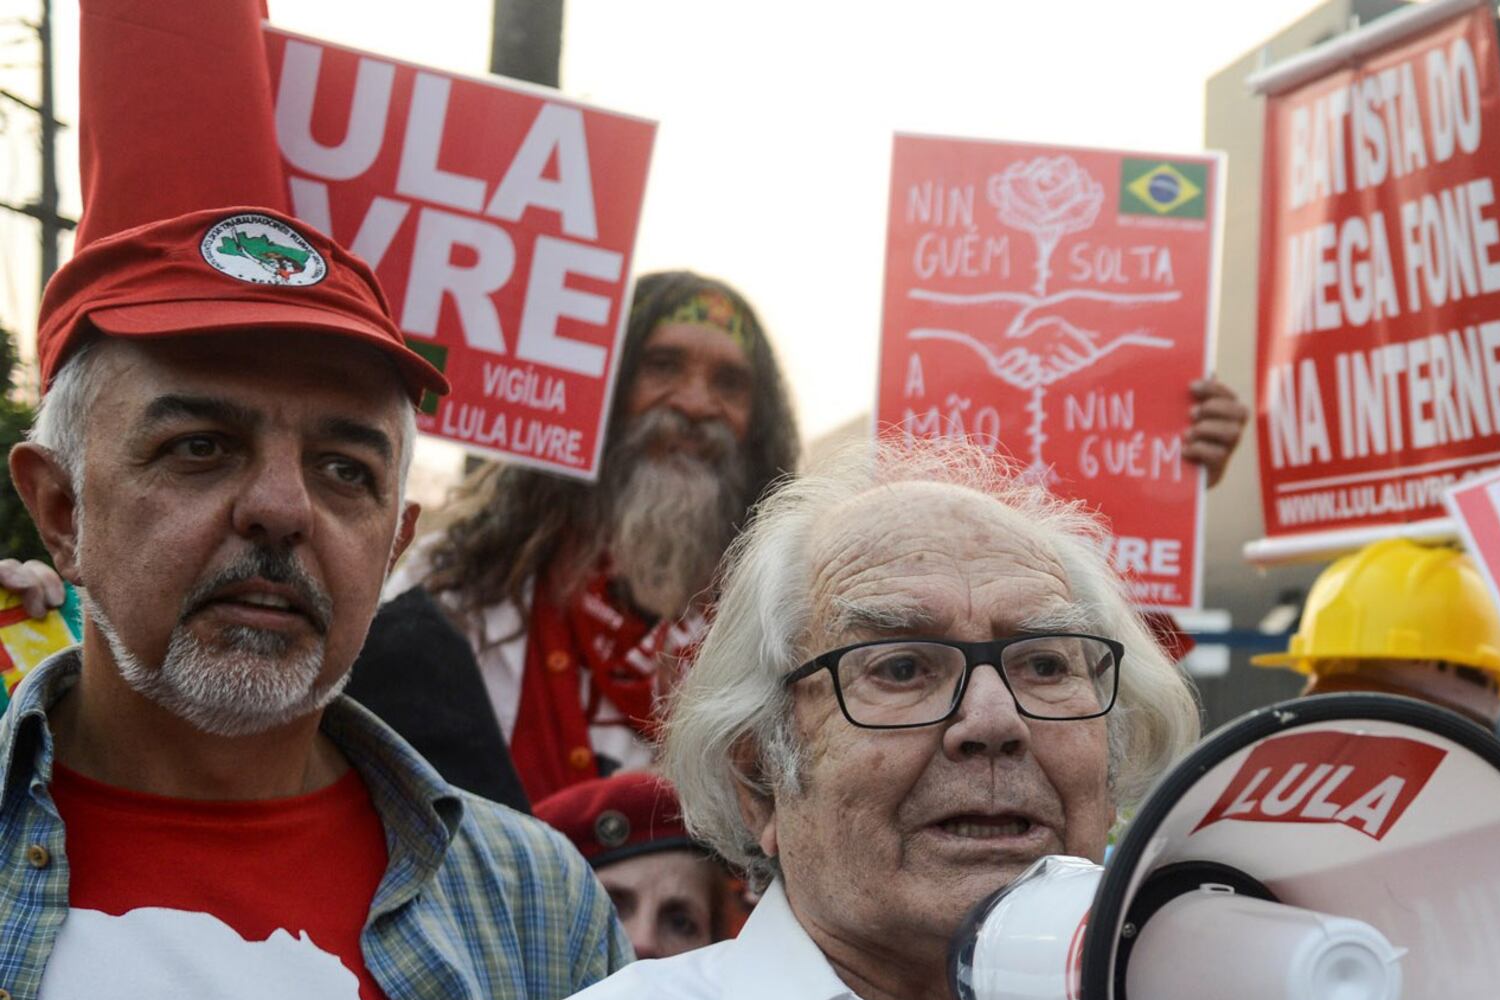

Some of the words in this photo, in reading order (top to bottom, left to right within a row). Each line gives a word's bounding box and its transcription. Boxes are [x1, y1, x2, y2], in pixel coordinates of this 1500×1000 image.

[275, 39, 598, 240] ULA
[1290, 61, 1427, 210] BATISTA
[1426, 38, 1481, 163] DO
[906, 180, 976, 227] NIN
[288, 176, 624, 378] VRE
[913, 224, 1010, 278] GUÉM
[1070, 241, 1174, 286] SOLTA
[1286, 211, 1400, 337] MEGA
[483, 362, 567, 414] VIGÍLIA
[905, 353, 925, 396] A
[442, 401, 507, 447] LULA
[512, 418, 585, 466] LIVRE.
[903, 395, 1001, 455] MÃO
[1065, 390, 1134, 432] NIN
[1268, 359, 1332, 470] NA
[1080, 433, 1182, 482] GUÉM
[1223, 760, 1407, 836] LULA
